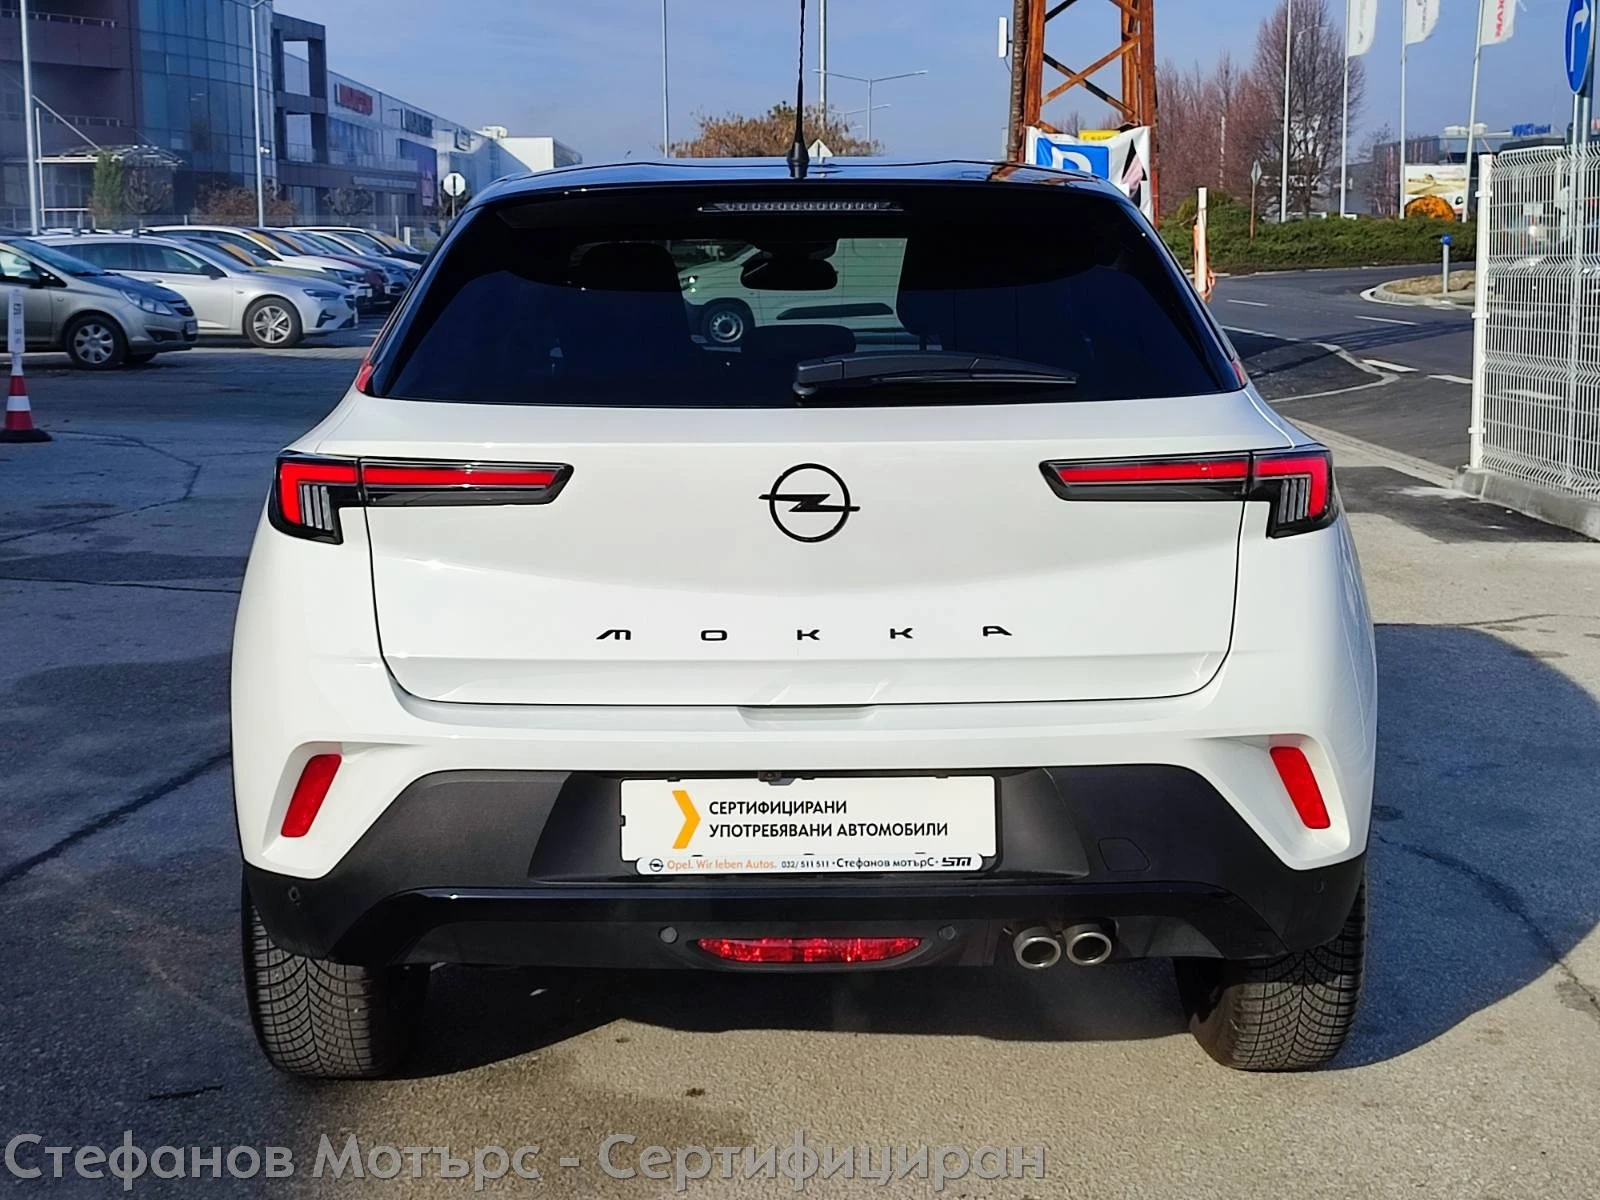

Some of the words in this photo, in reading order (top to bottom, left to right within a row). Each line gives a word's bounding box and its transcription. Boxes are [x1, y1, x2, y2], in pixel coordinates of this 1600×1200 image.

[596, 625, 1013, 642] MOKKA
[708, 800, 848, 817] СЕРТИФИЦИРАНИ
[709, 823, 833, 838] УПОТРЕБЯВАНИ
[836, 822, 949, 837] АВТОМОБИЛИ
[696, 860, 713, 869] Wir
